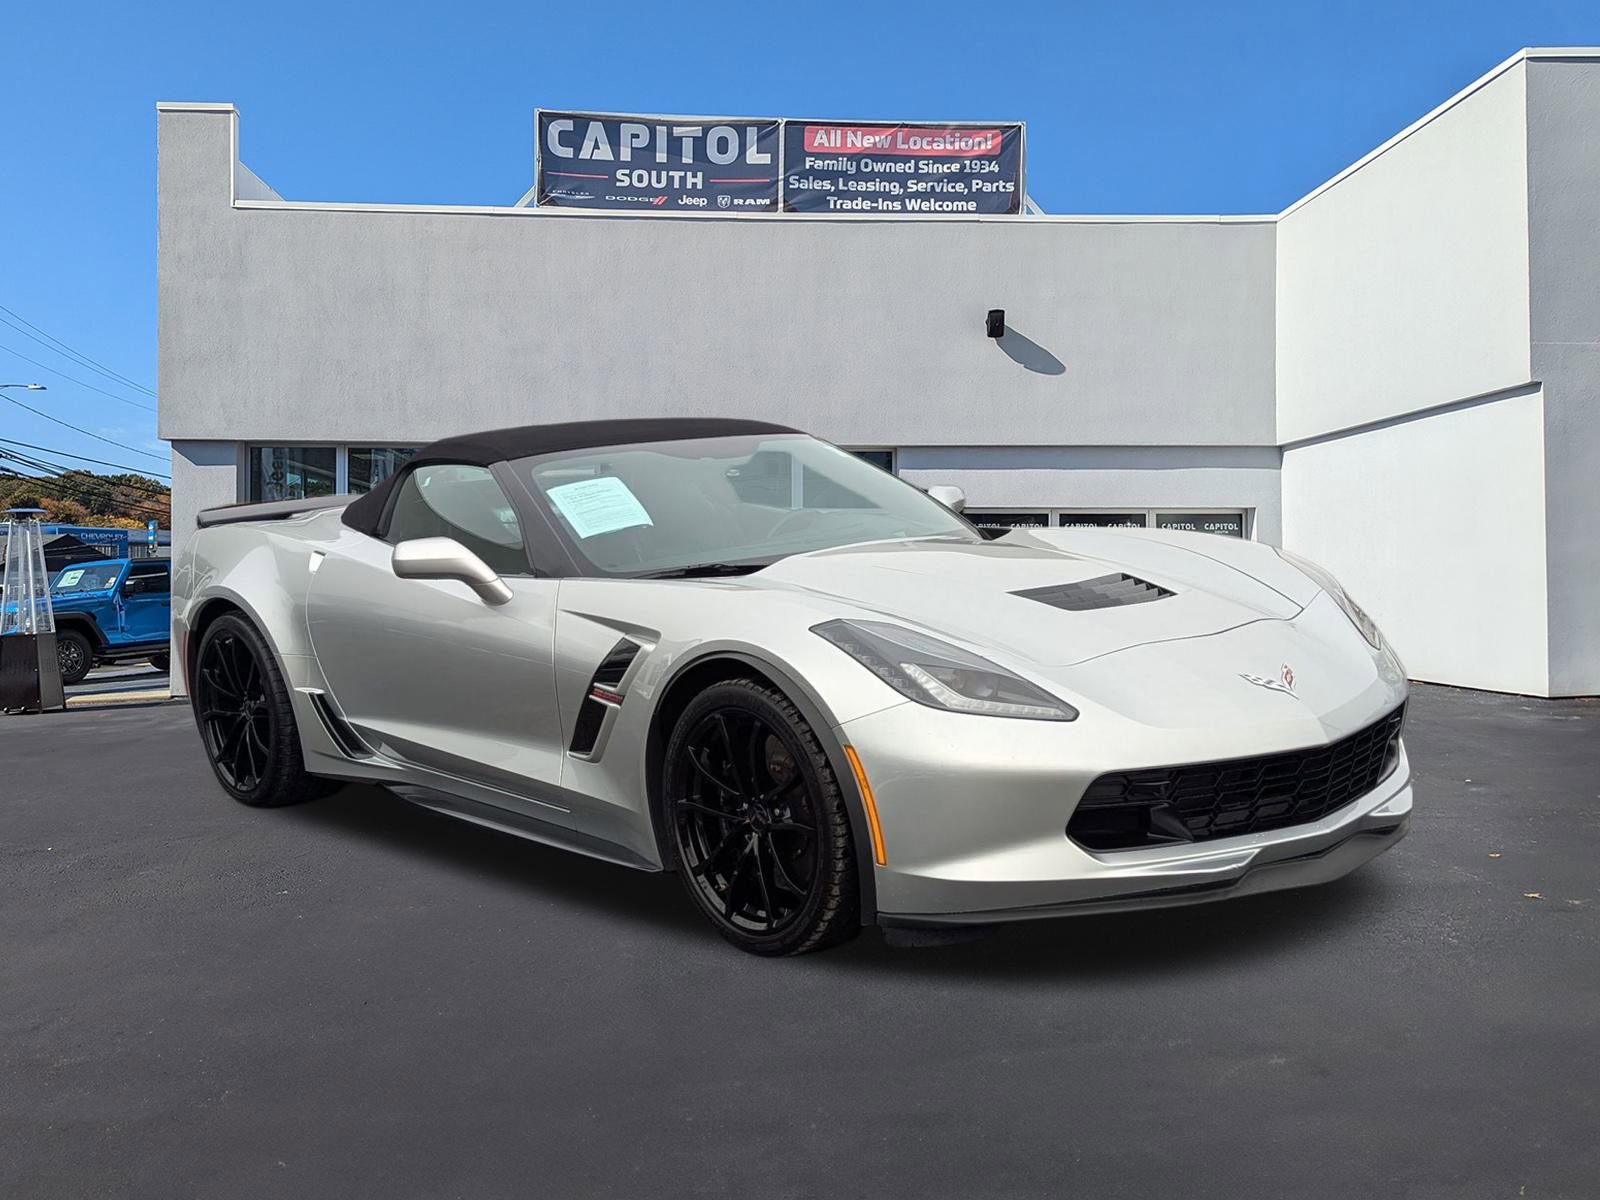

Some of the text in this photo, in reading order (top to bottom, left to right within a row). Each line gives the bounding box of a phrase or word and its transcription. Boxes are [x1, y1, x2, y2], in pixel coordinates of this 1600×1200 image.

[547, 119, 771, 165] CAPITOL
[813, 129, 993, 151] All New Location!
[805, 156, 1000, 174] Family Owned Since 1934
[615, 169, 703, 189] SOUTH
[788, 175, 1015, 194] Sales, Leasing, Service, Parts
[678, 194, 708, 207] Jeep
[827, 196, 977, 211] Trade-Ins Welcome
